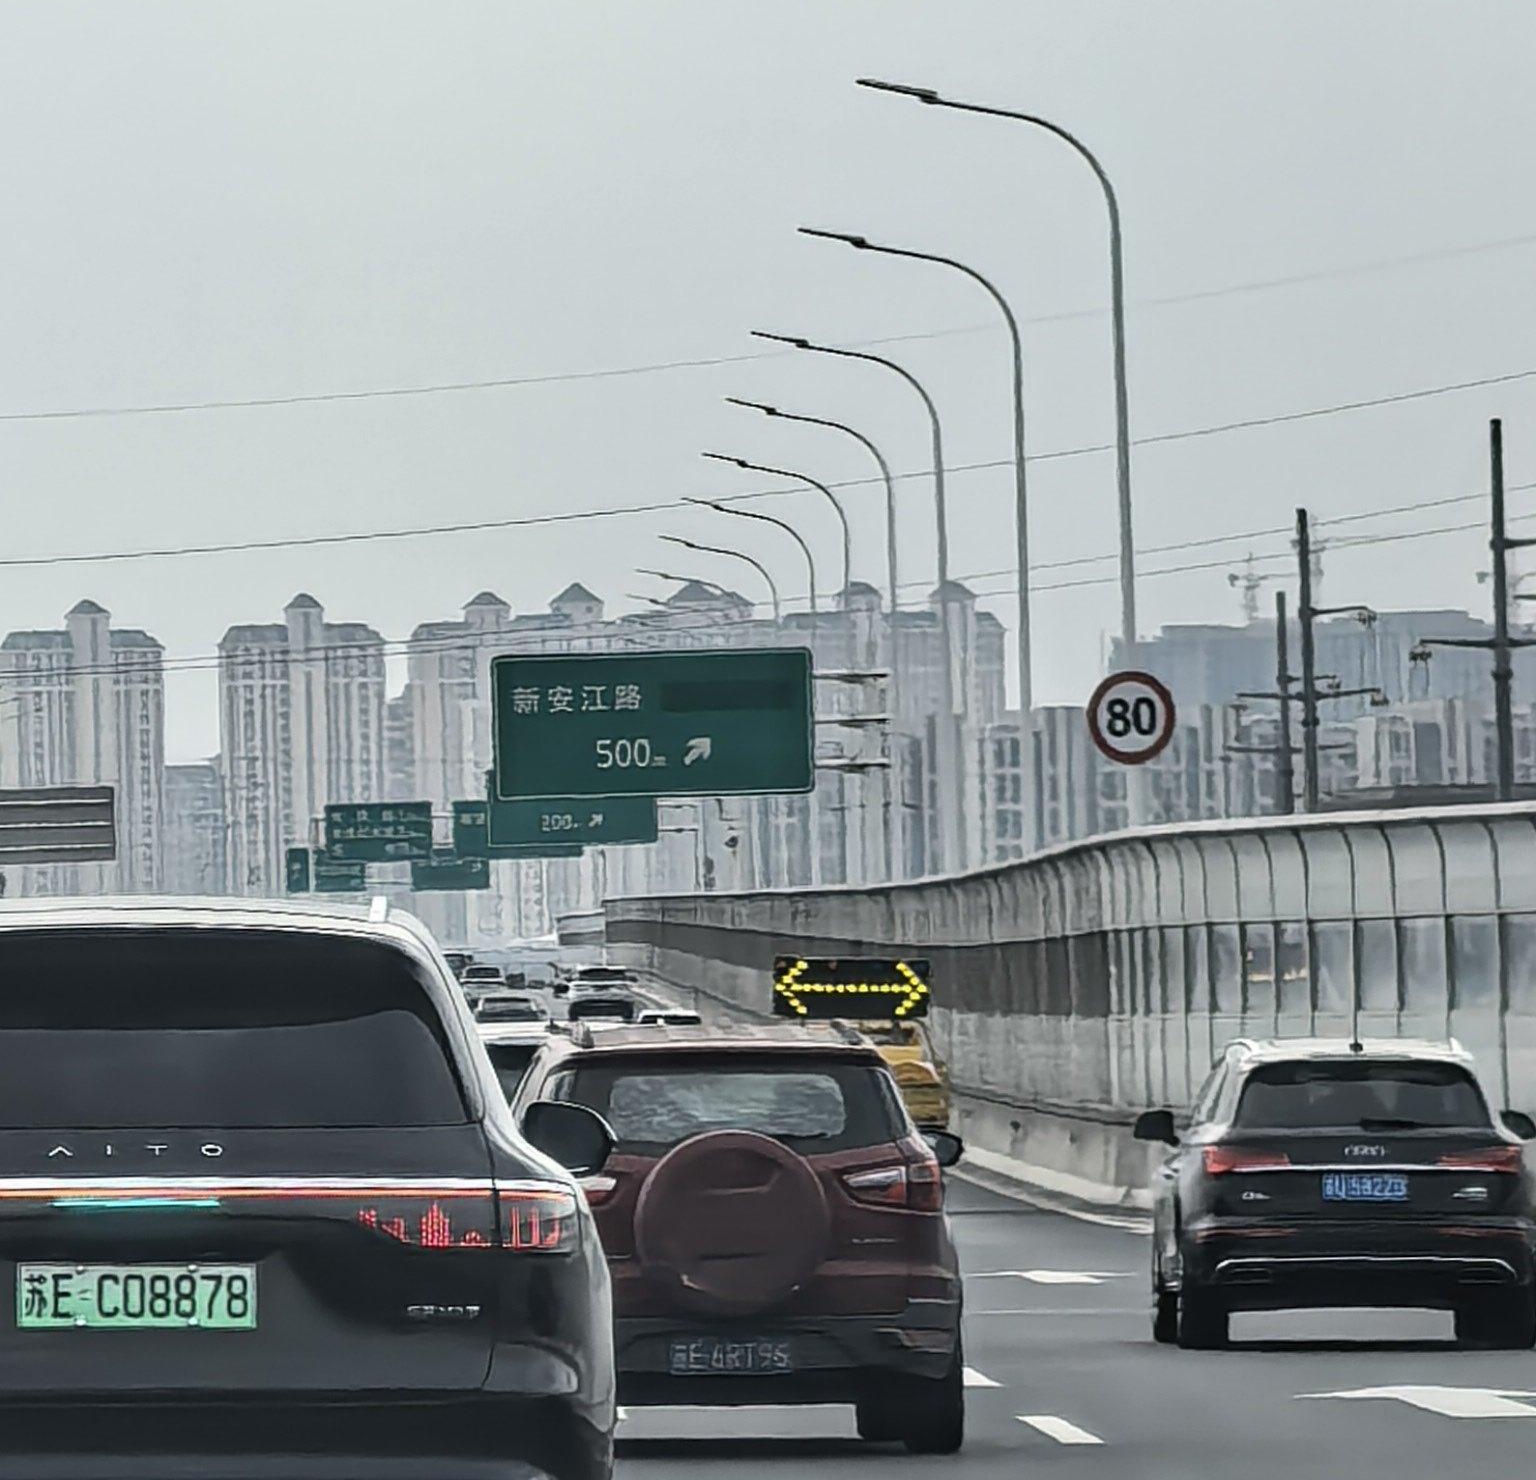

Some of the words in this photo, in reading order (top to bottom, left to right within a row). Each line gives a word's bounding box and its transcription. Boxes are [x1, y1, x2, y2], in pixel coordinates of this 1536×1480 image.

[512, 684, 642, 714] 新安江路
[1106, 697, 1156, 738] 80
[48, 1144, 223, 1157] AITO
